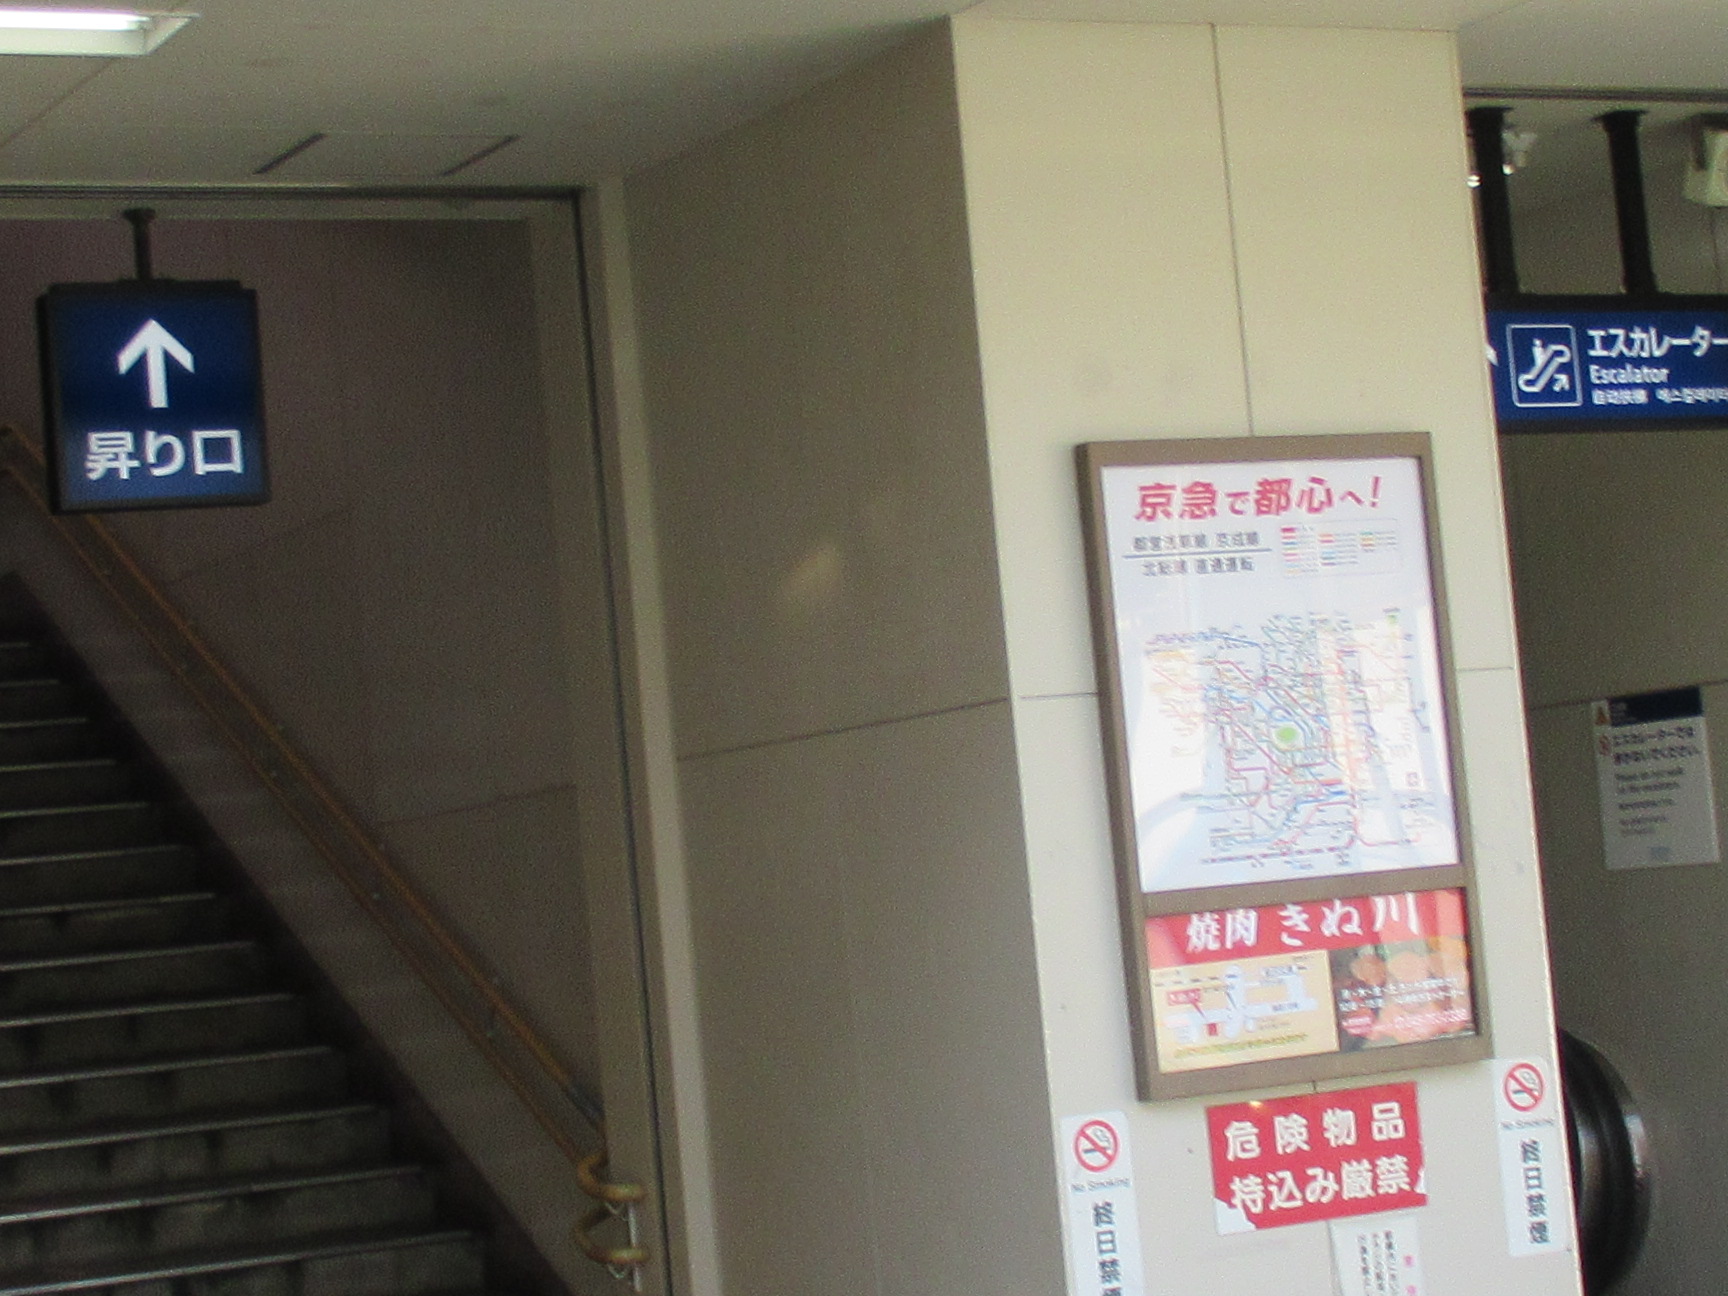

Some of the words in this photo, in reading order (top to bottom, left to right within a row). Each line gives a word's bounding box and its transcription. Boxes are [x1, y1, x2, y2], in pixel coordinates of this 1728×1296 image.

[1588, 362, 1670, 384] Escalator
[84, 429, 244, 480] 昇り口
[1186, 908, 1259, 953] 焼肉
[1277, 891, 1420, 947] きぬ川
[1224, 1101, 1406, 1162] 危険物品
[1230, 1154, 1412, 1214] 持込み厳禁
